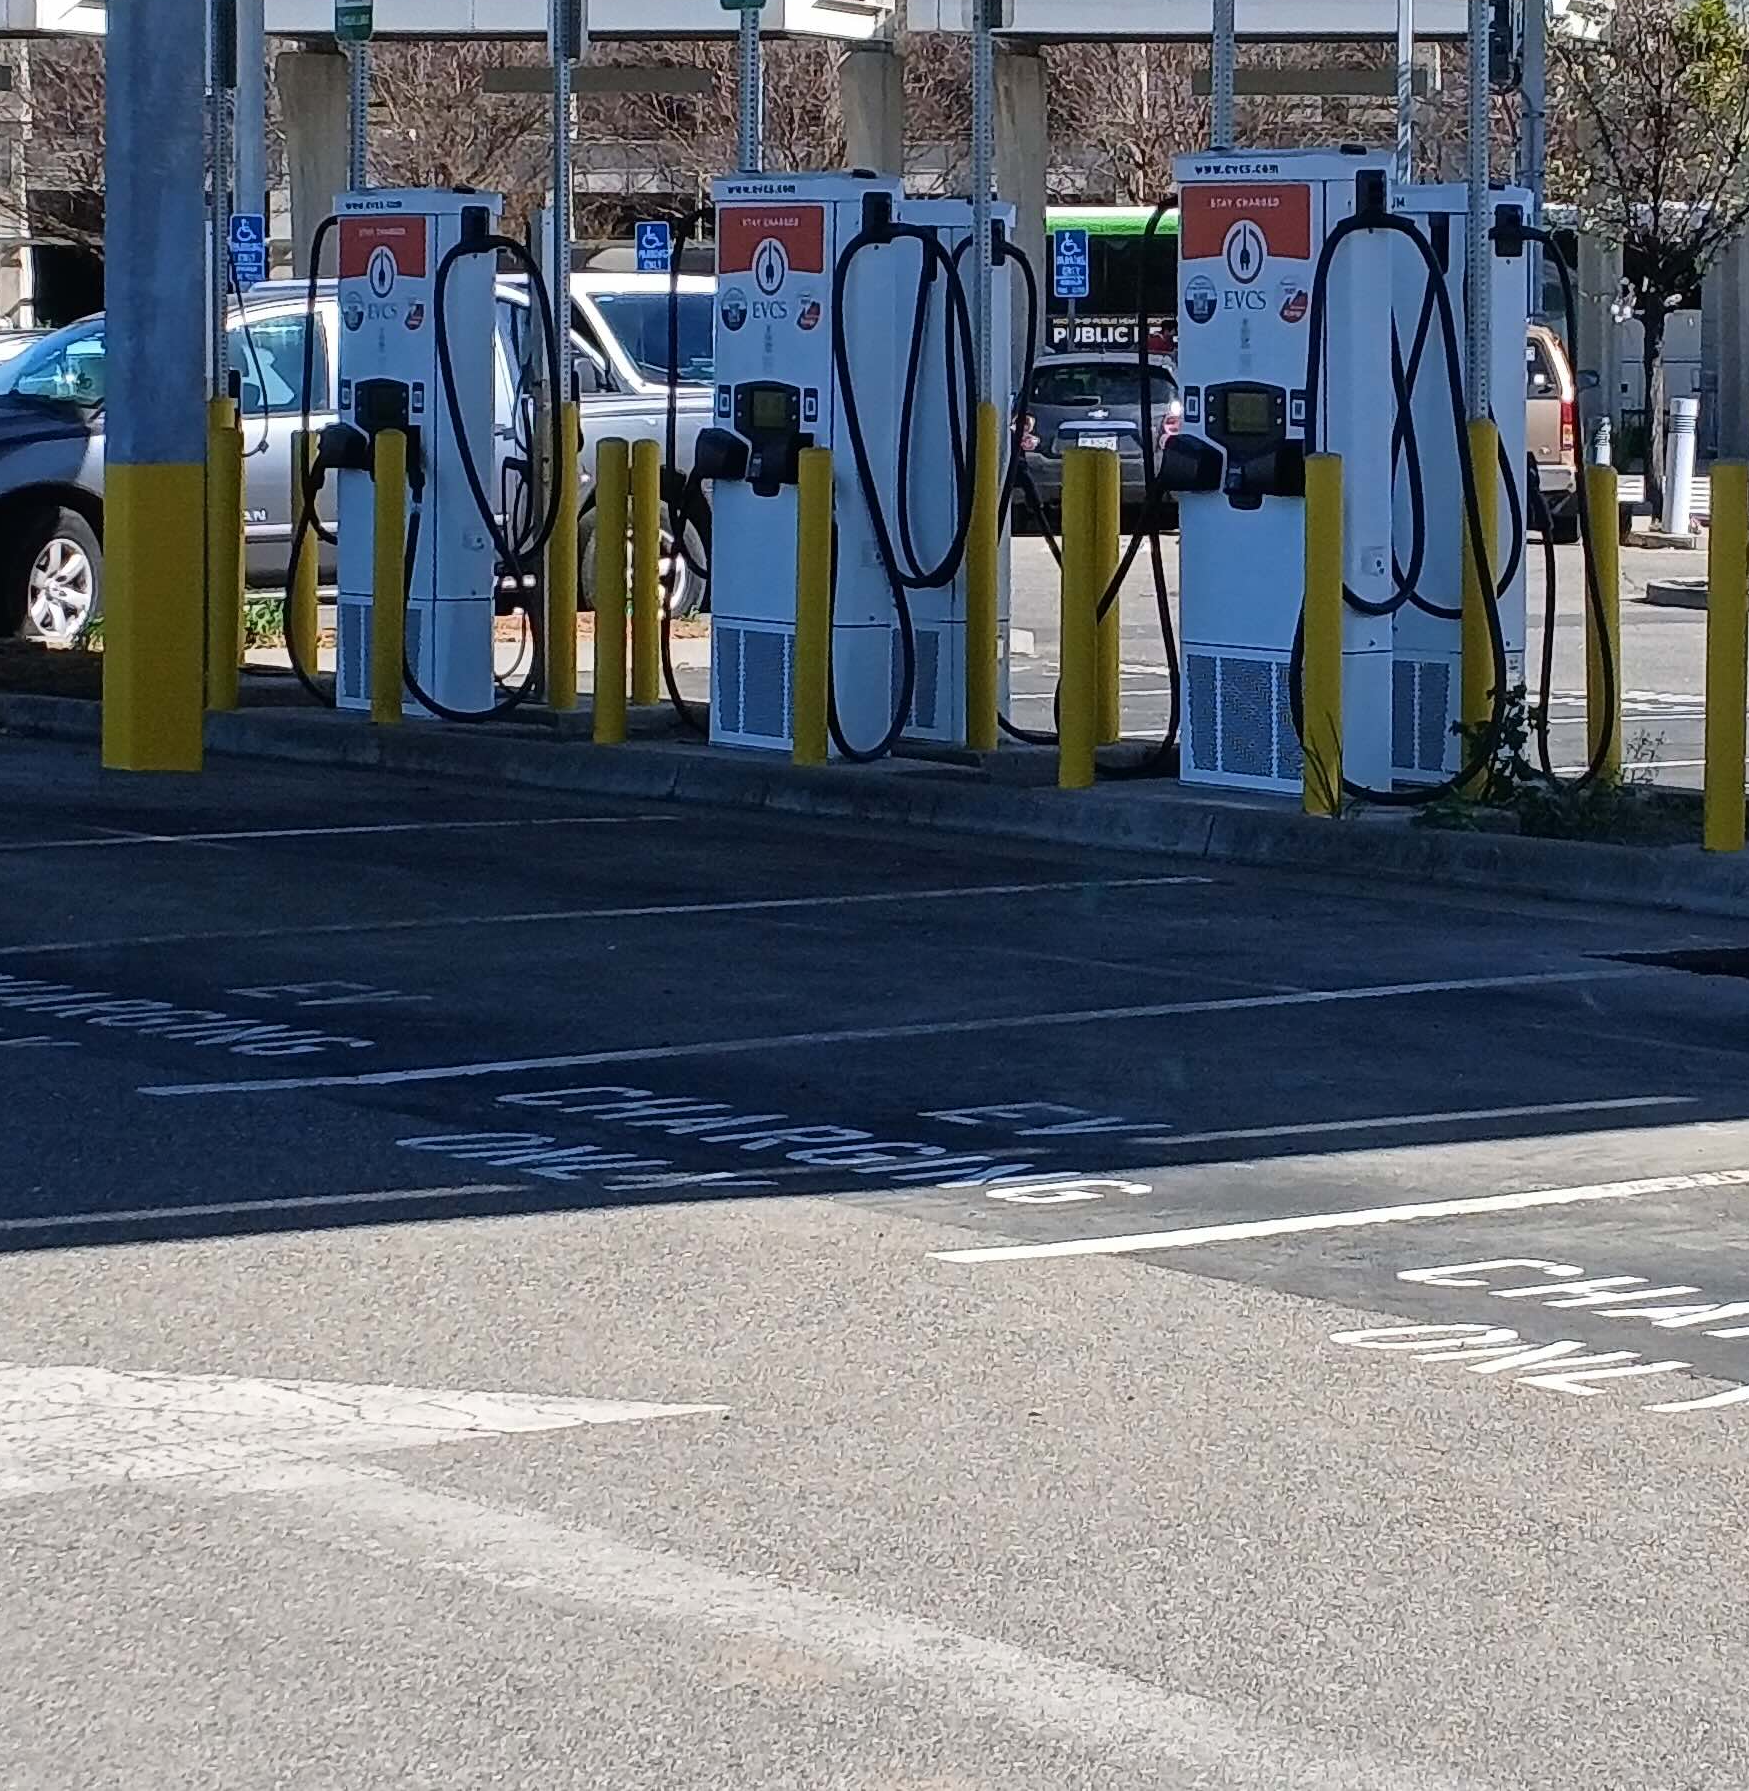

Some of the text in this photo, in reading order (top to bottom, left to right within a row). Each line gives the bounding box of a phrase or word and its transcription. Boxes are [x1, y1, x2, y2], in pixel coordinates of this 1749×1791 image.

[1195, 164, 1279, 175] www.evcs.com
[1210, 197, 1279, 208] STAY CHARGED
[752, 300, 788, 319] EVCS
[1223, 289, 1267, 311] EVCS
[367, 302, 397, 320] EVCS
[1053, 326, 1129, 344] PUBLIC
[225, 980, 433, 1006] EV
[917, 1100, 1174, 1137] EV
[493, 1085, 1154, 1204] CHARGING
[393, 1131, 781, 1193] ONLY
